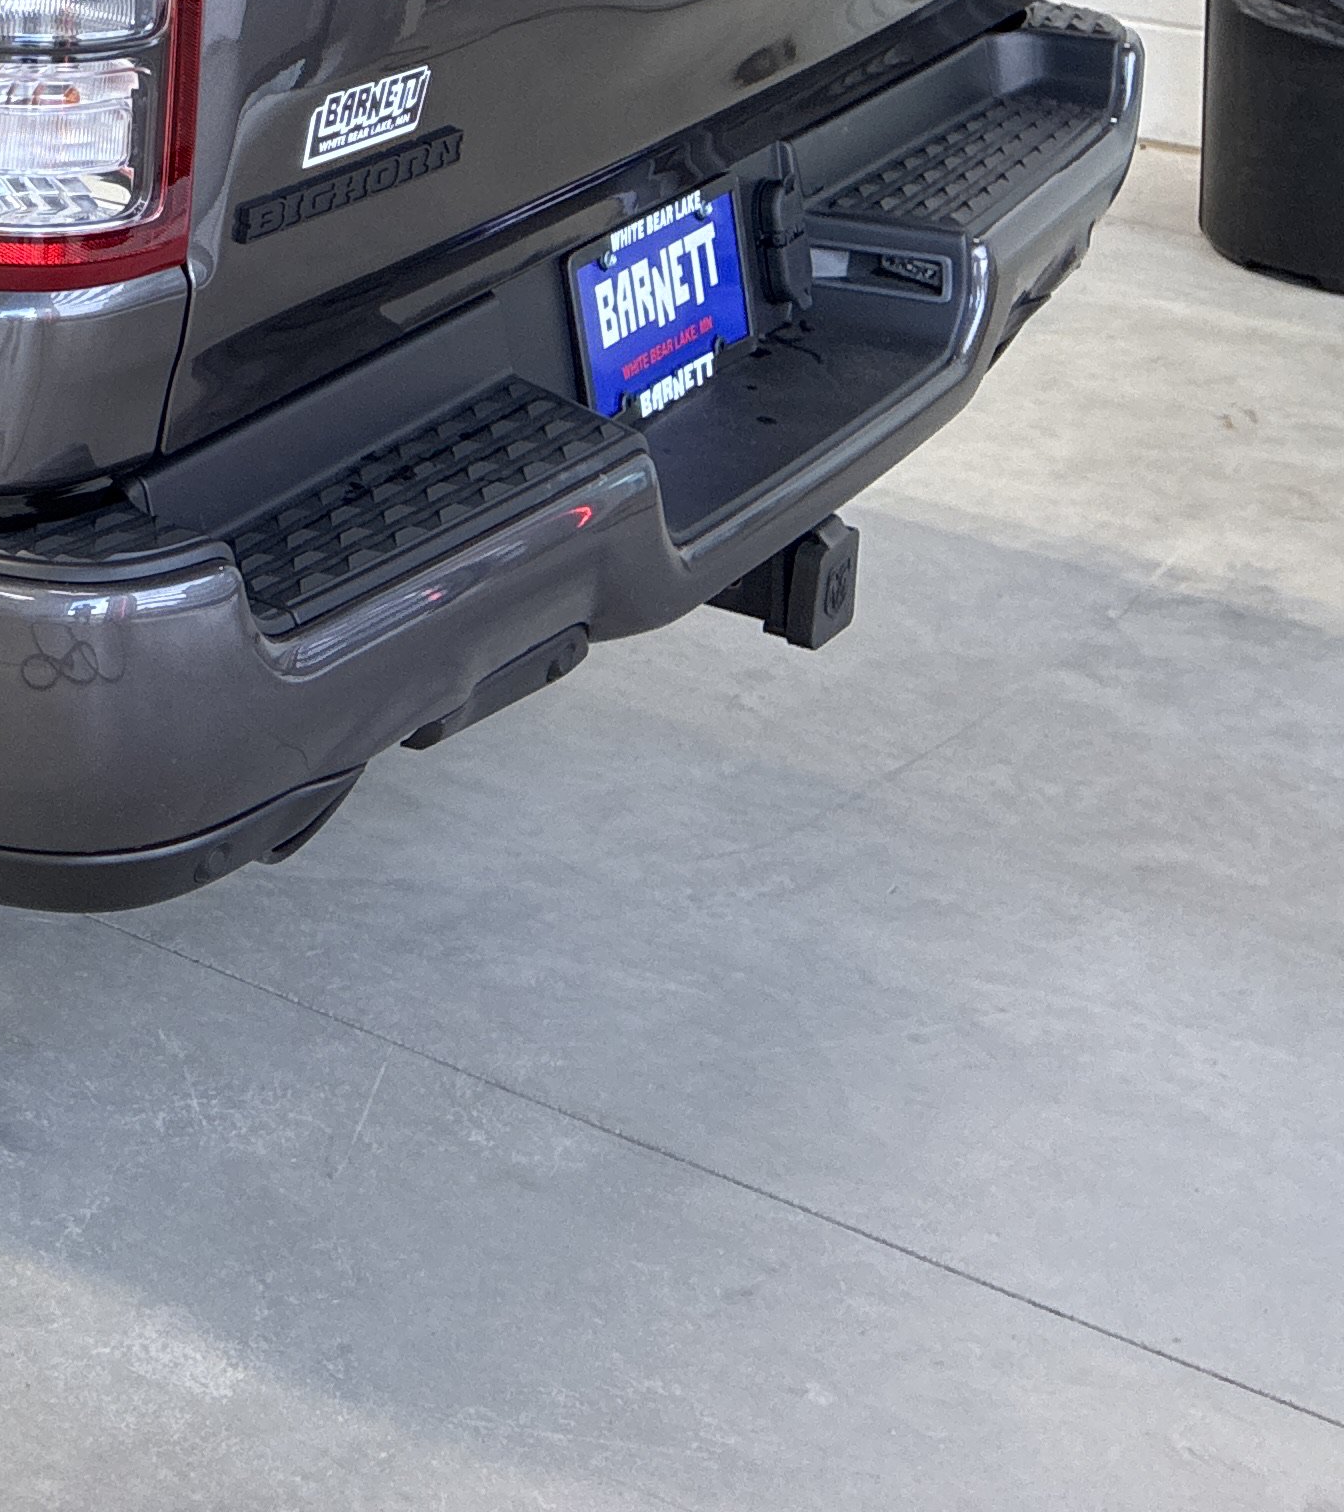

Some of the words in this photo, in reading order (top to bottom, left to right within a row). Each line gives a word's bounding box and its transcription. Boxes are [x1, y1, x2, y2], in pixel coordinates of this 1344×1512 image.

[323, 69, 427, 128] BARNETT
[318, 138, 347, 154] WHITE
[347, 127, 370, 144] BEAR
[395, 112, 411, 127] MN
[610, 218, 645, 252] WHITE
[645, 204, 674, 236] BEAR
[594, 220, 719, 350] BARNETT
[621, 353, 650, 381] WHITE
[649, 339, 674, 365] BEAR
[639, 351, 715, 419] BARNETT
